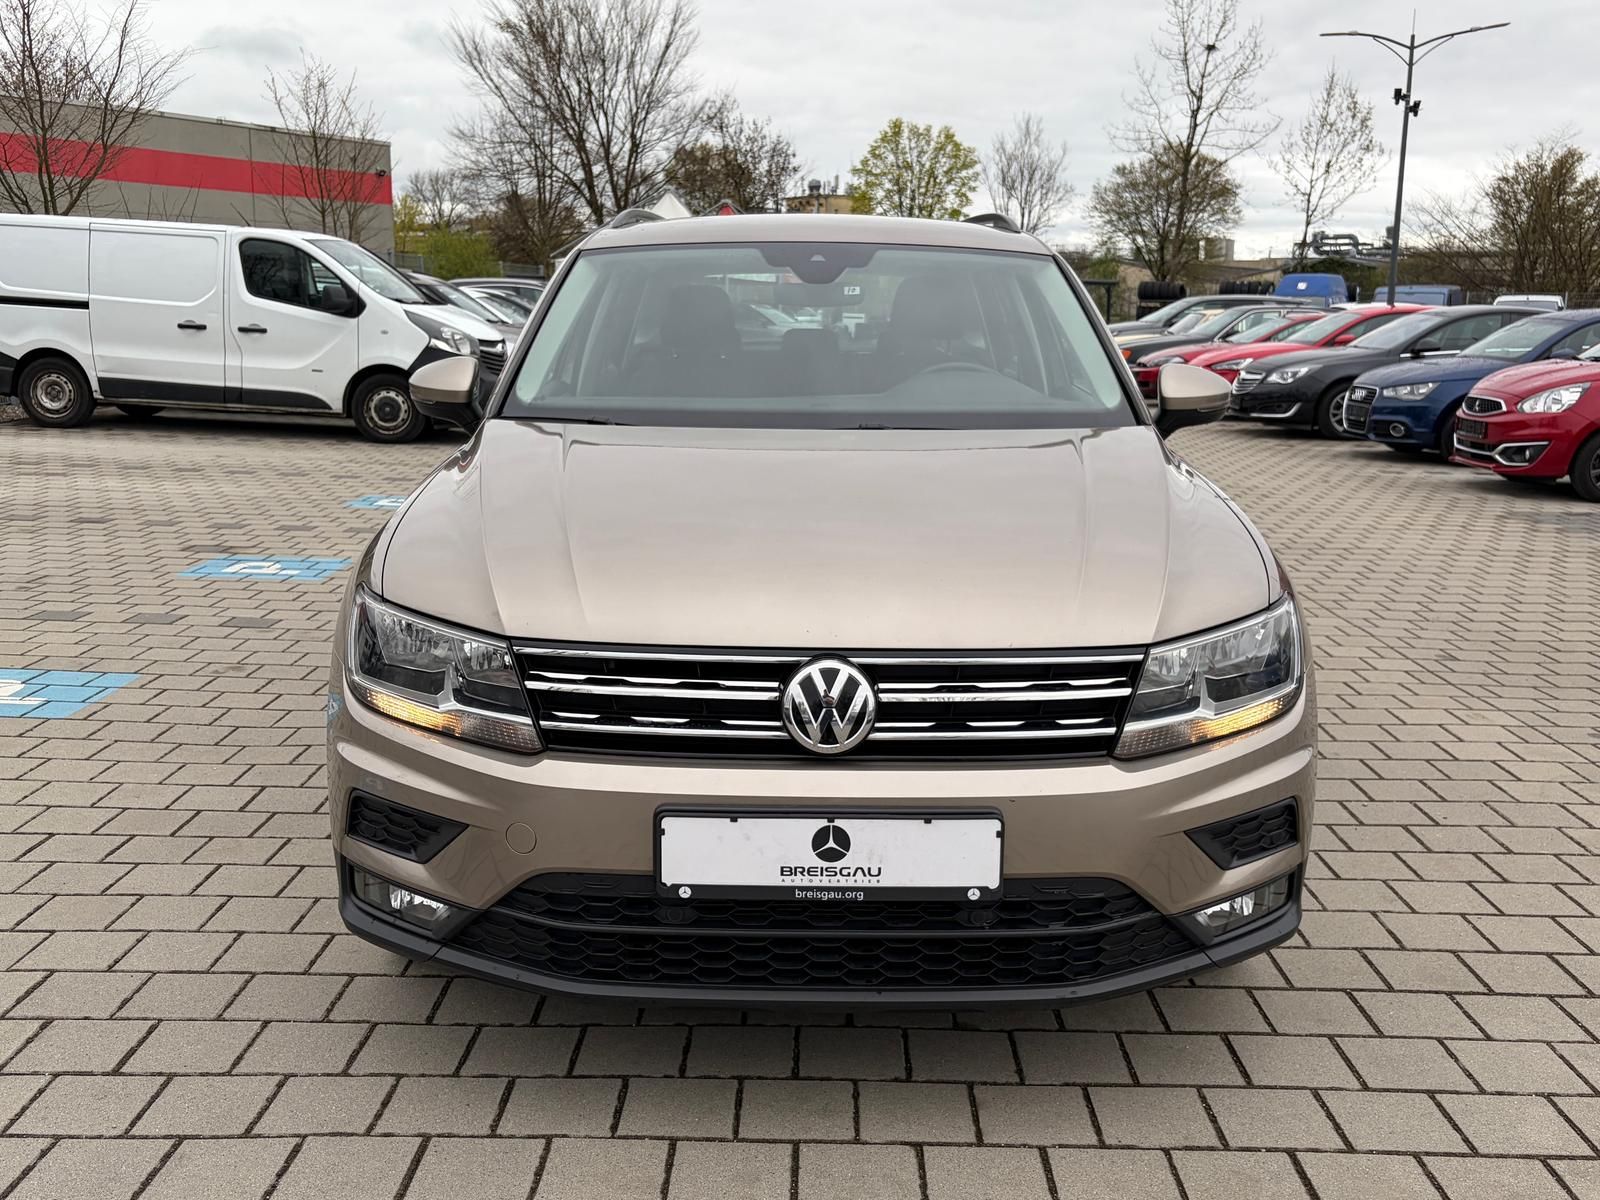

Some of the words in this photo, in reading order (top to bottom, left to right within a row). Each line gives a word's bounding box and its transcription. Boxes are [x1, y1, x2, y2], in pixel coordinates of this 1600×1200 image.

[786, 663, 872, 750] VW
[780, 866, 882, 877] BREISGAU
[795, 889, 864, 900] breisgau.org
